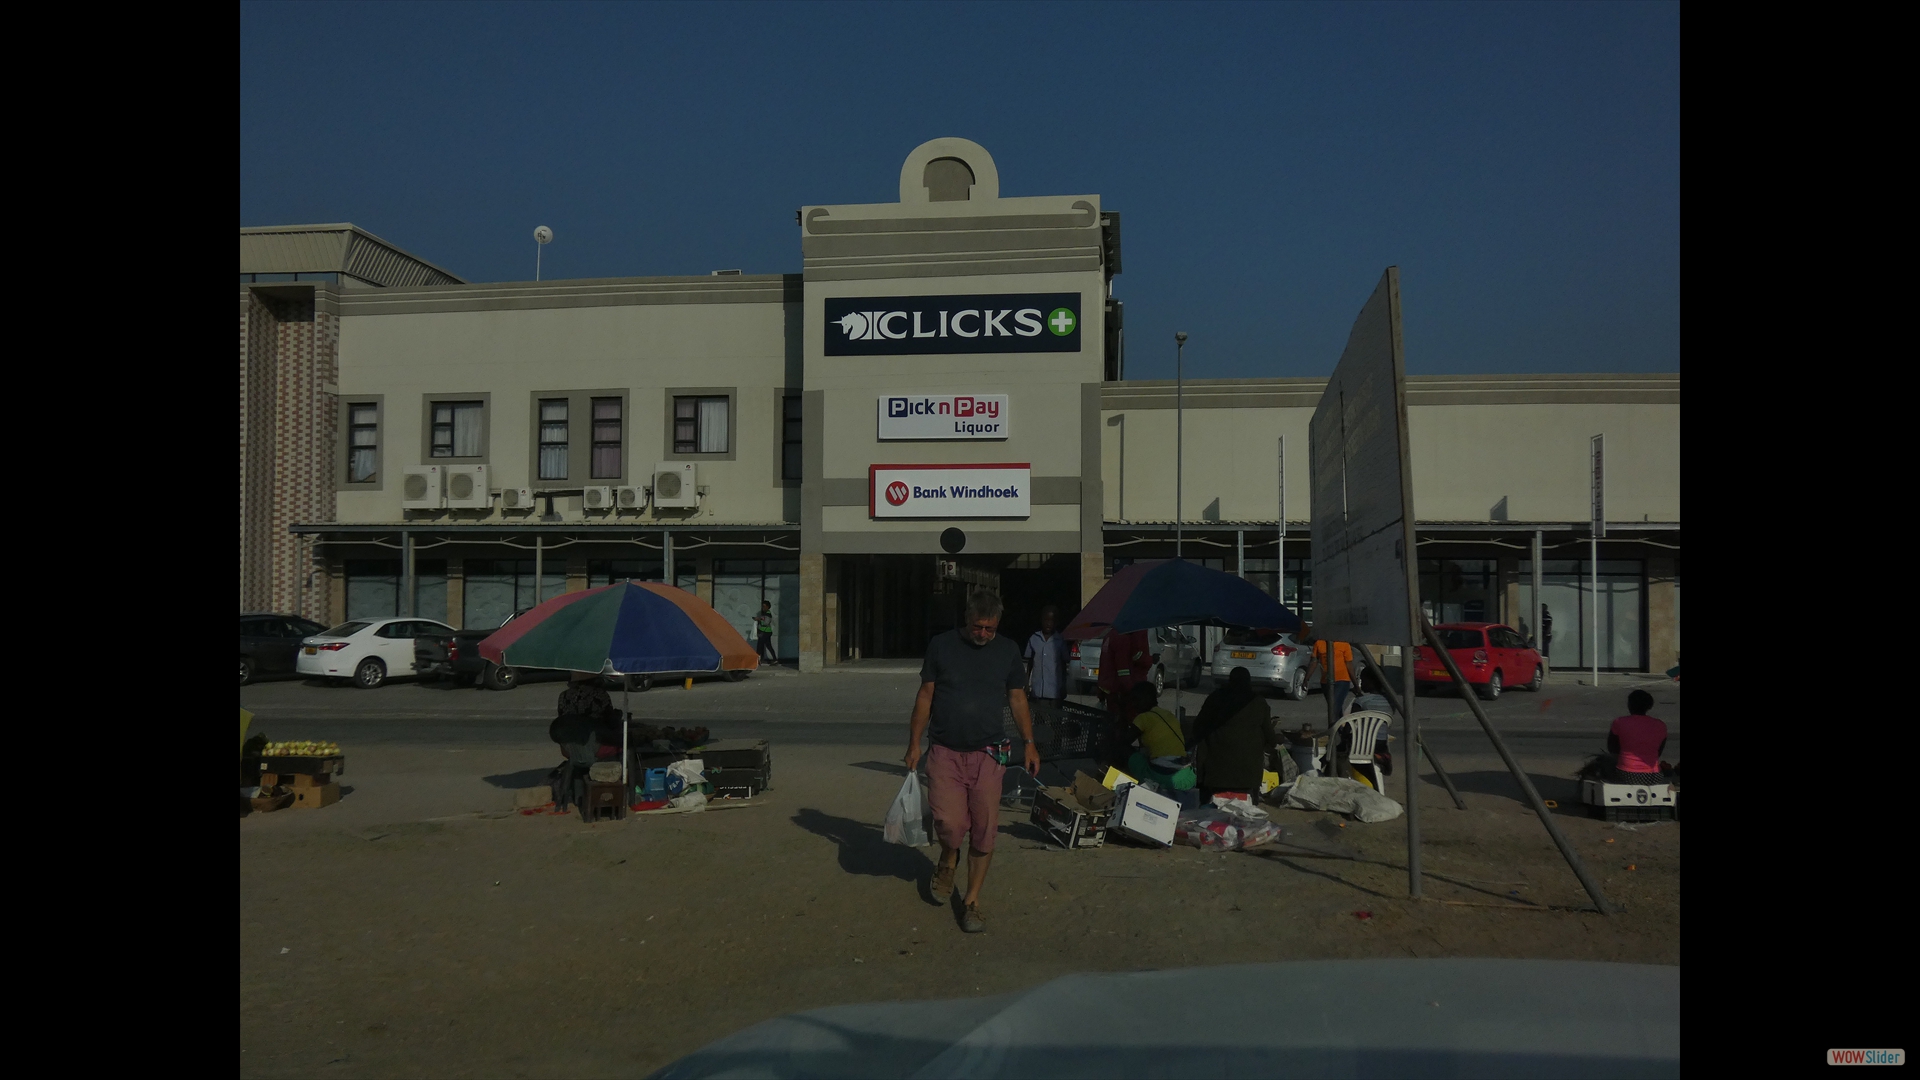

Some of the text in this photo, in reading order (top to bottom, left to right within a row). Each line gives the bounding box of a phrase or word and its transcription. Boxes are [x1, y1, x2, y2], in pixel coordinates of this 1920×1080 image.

[878, 308, 1043, 339] CLICKS
[889, 397, 999, 418] Pick n Pay
[954, 421, 1000, 435] Liquor
[913, 486, 947, 498] Bank
[950, 485, 1019, 498] Windhoek
